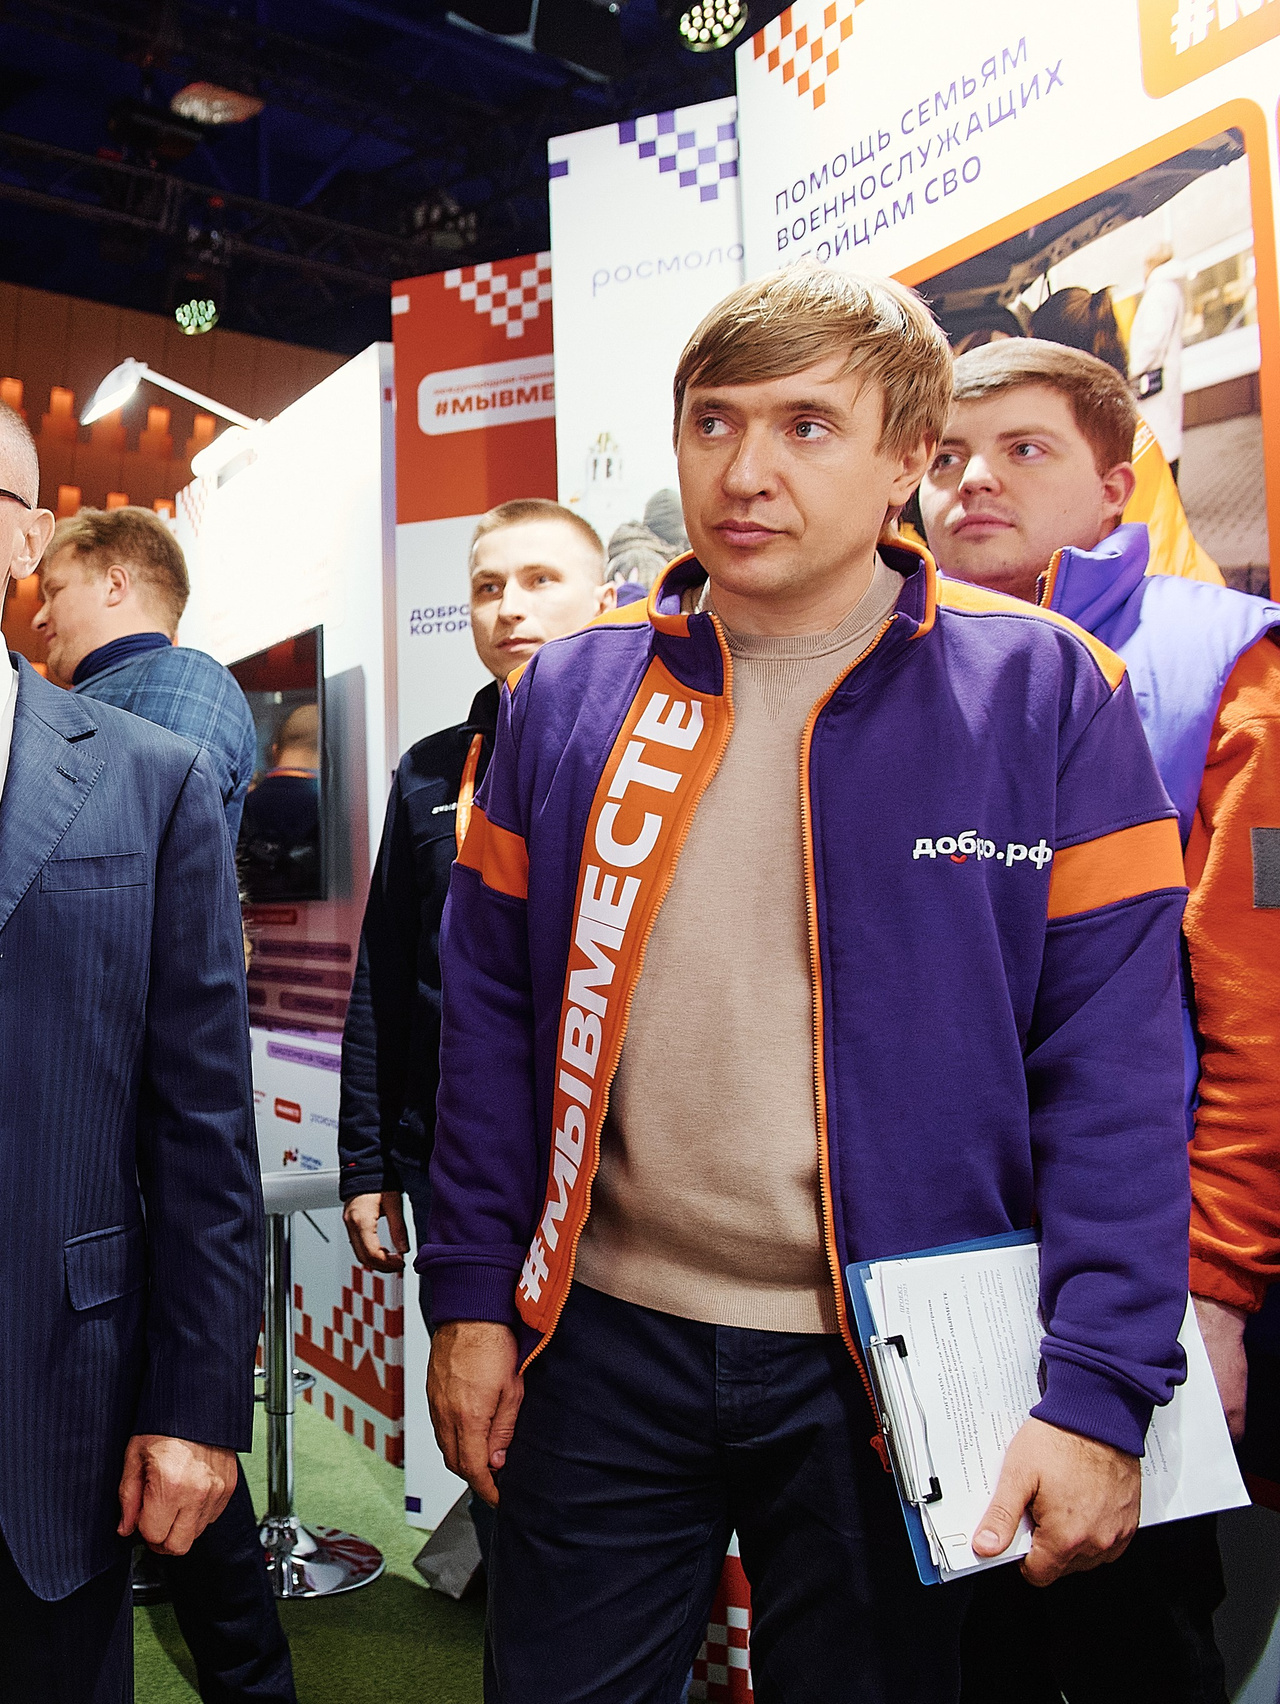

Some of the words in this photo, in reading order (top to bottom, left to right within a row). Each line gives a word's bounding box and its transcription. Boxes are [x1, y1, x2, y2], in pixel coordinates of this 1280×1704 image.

[775, 130, 891, 215] ПОМОЩЬ
[900, 36, 1028, 135] СЕМЬЯМ
[777, 59, 1064, 251] ВОЕННОСЛУЖАЩИХ
[801, 192, 915, 264] ОЙЦАМ
[924, 156, 981, 204] СВО
[435, 382, 554, 417] #МЫВМЕ
[912, 830, 1053, 870] добро.рф
[519, 692, 704, 1303] #МЫВМЕСТЕ
[938, 1373, 951, 1420] ПРОГРАММА
